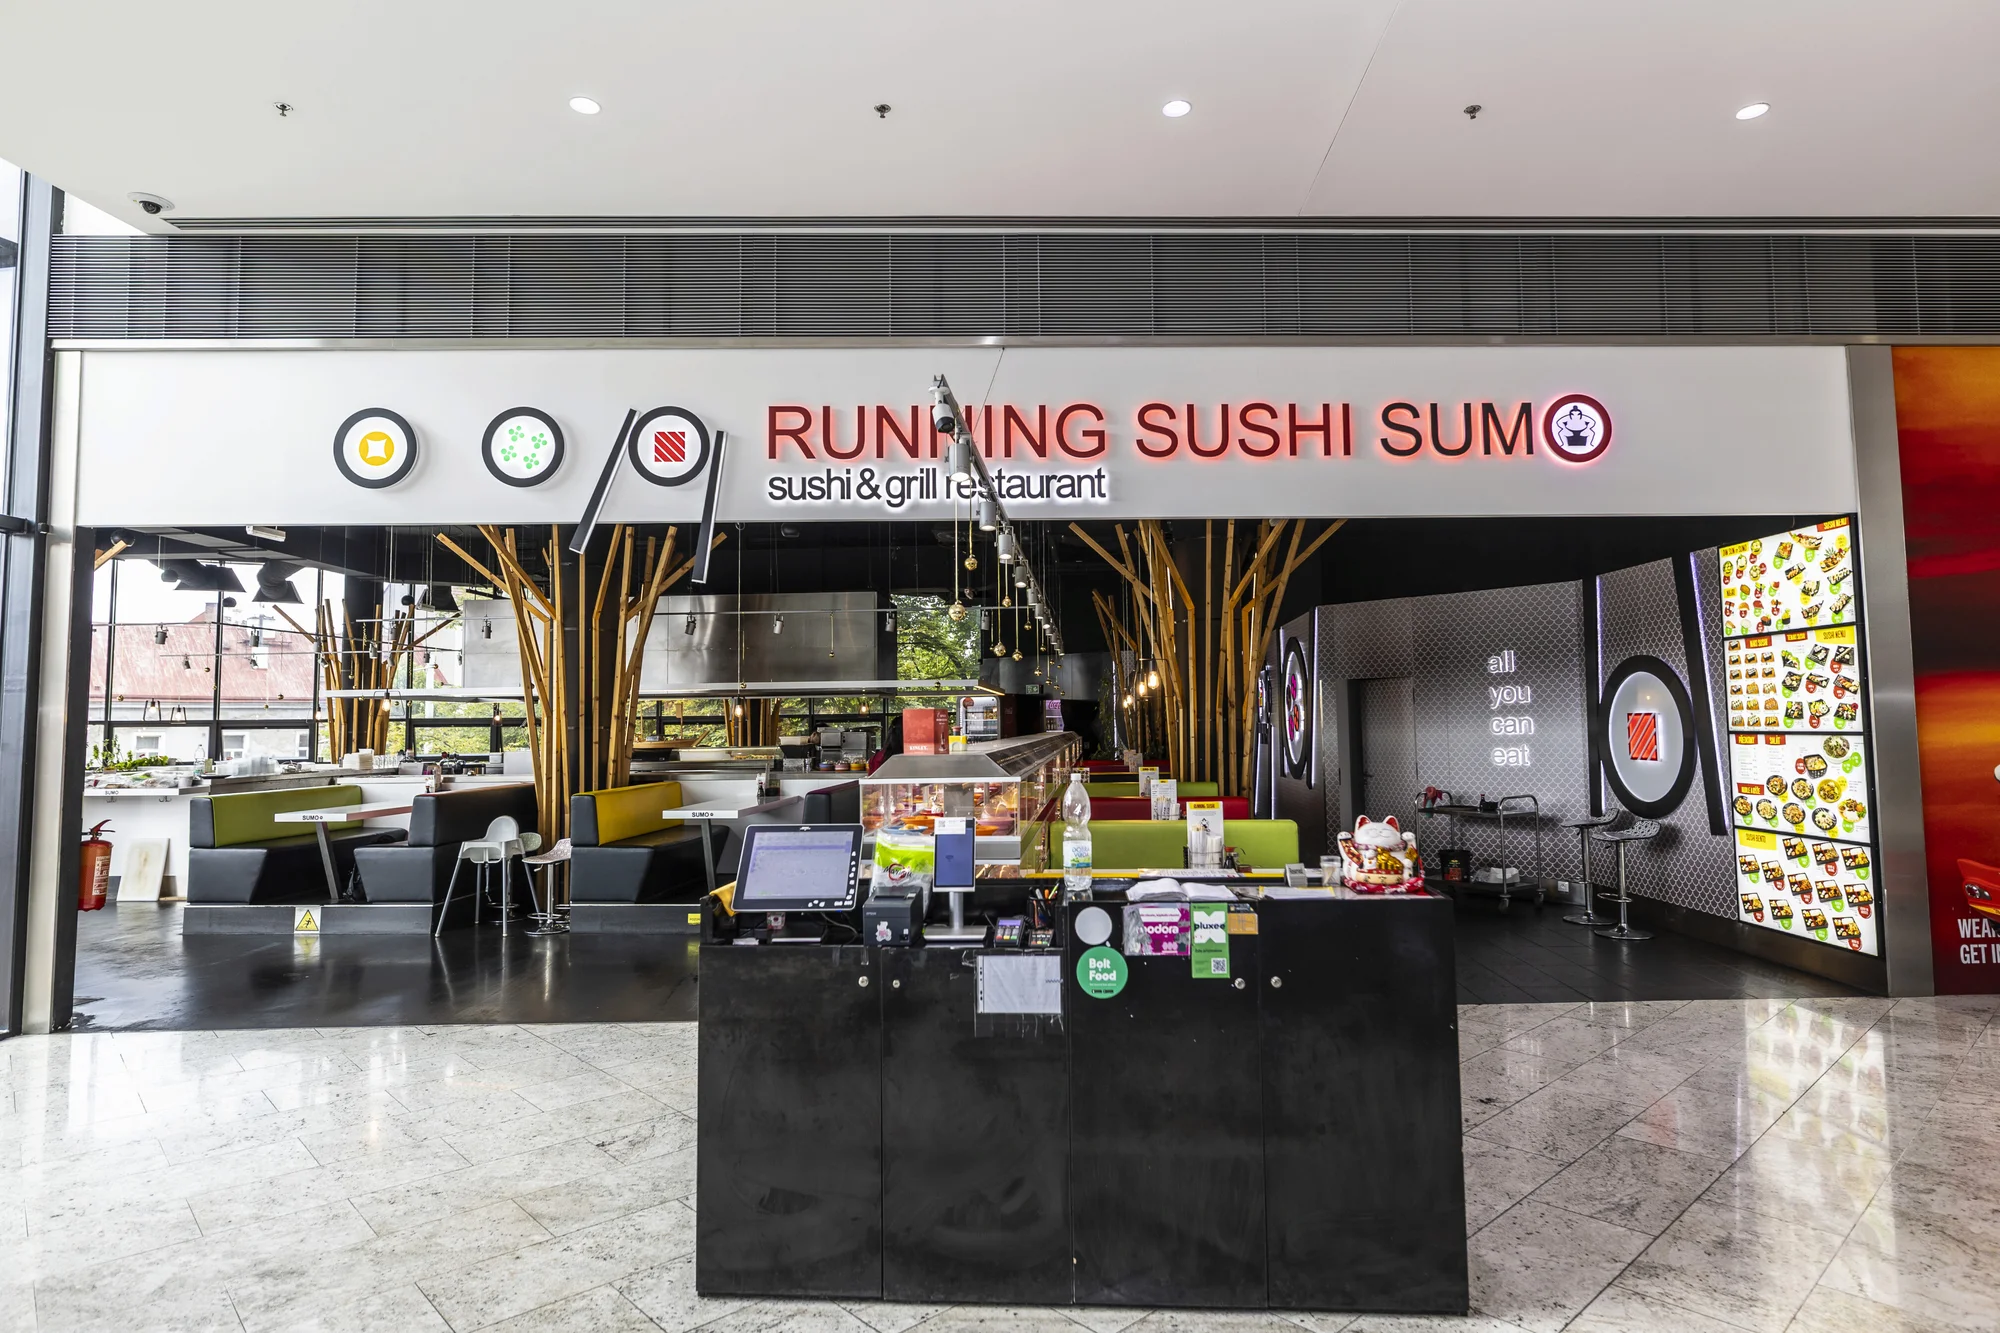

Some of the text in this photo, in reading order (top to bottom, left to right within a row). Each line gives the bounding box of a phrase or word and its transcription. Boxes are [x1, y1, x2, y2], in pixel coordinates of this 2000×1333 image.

[1136, 402, 1351, 458] SUSHI
[1487, 649, 1515, 673] all
[1489, 685, 1531, 709] you
[1490, 716, 1534, 735] can
[1491, 744, 1531, 766] eat
[1138, 923, 1179, 935] odora
[1194, 921, 1226, 932] pluxee
[1088, 957, 1111, 970] Bolt
[1960, 943, 1988, 965] GET
[1089, 969, 1117, 981] Food
